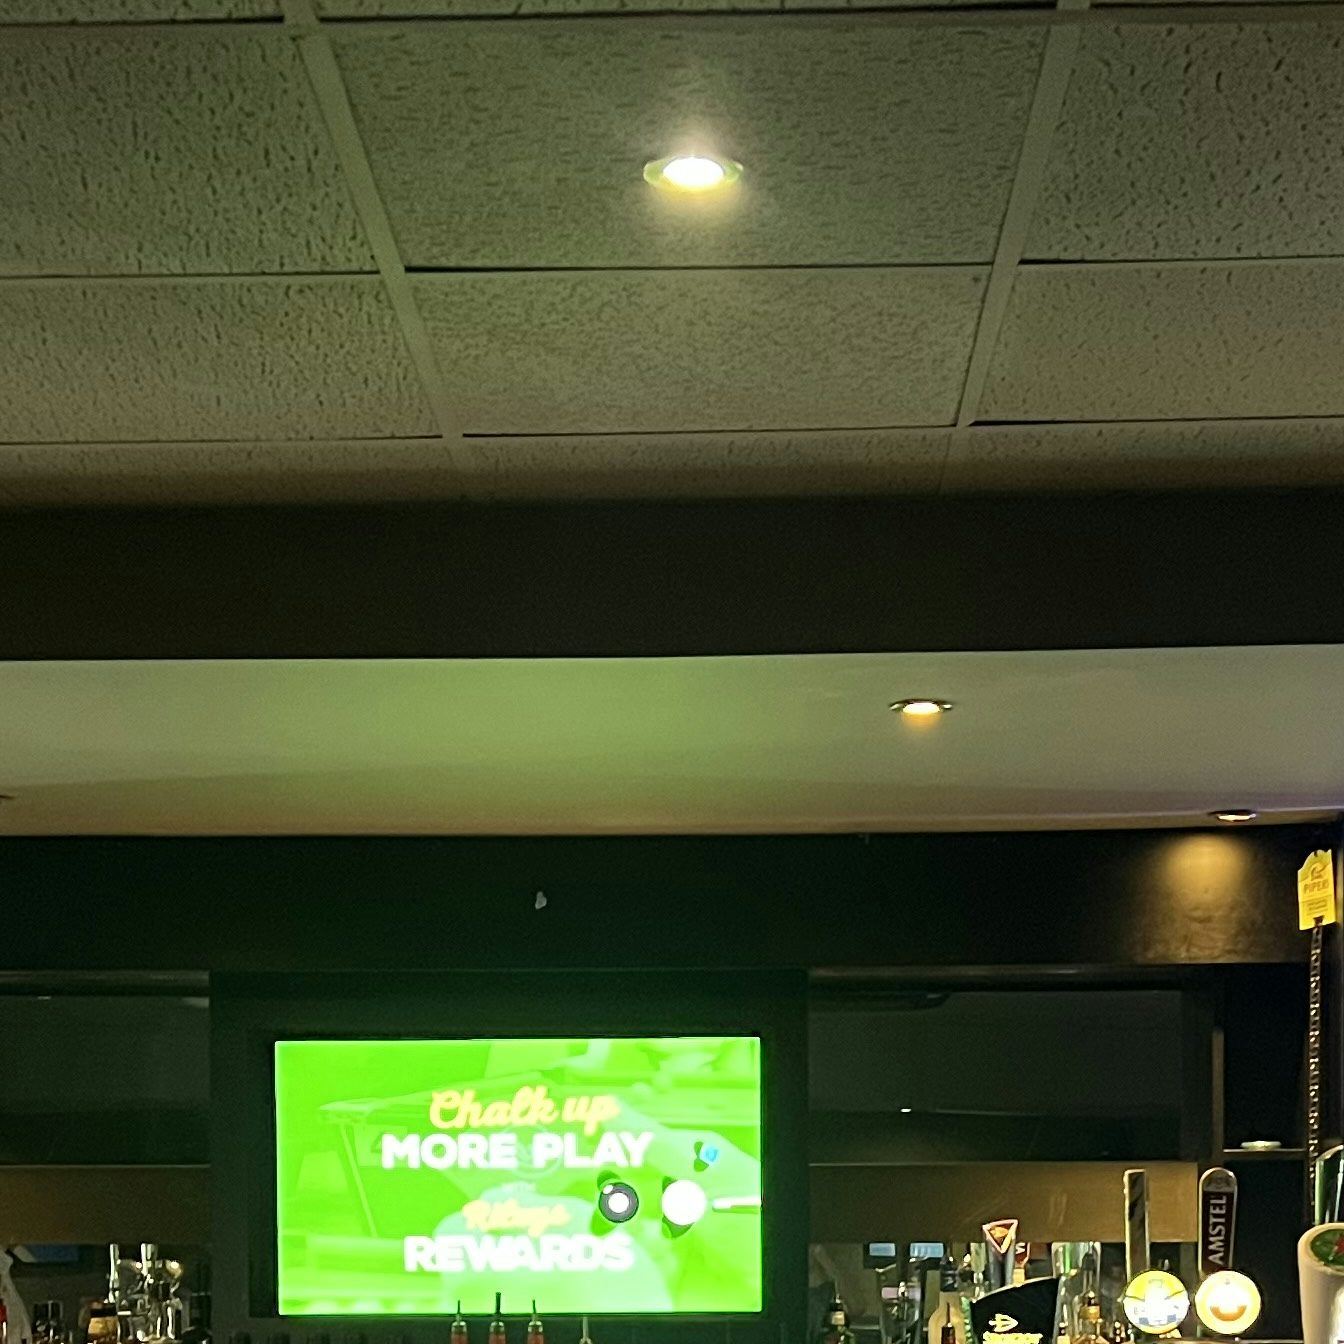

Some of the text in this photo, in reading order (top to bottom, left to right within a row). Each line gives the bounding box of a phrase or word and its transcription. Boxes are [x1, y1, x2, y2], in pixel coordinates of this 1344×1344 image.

[429, 1085, 622, 1136] Chalk up
[381, 1133, 654, 1169] MORE PLAY
[1208, 1195, 1227, 1266] AMSTEL
[403, 1234, 636, 1272] REWARDS
